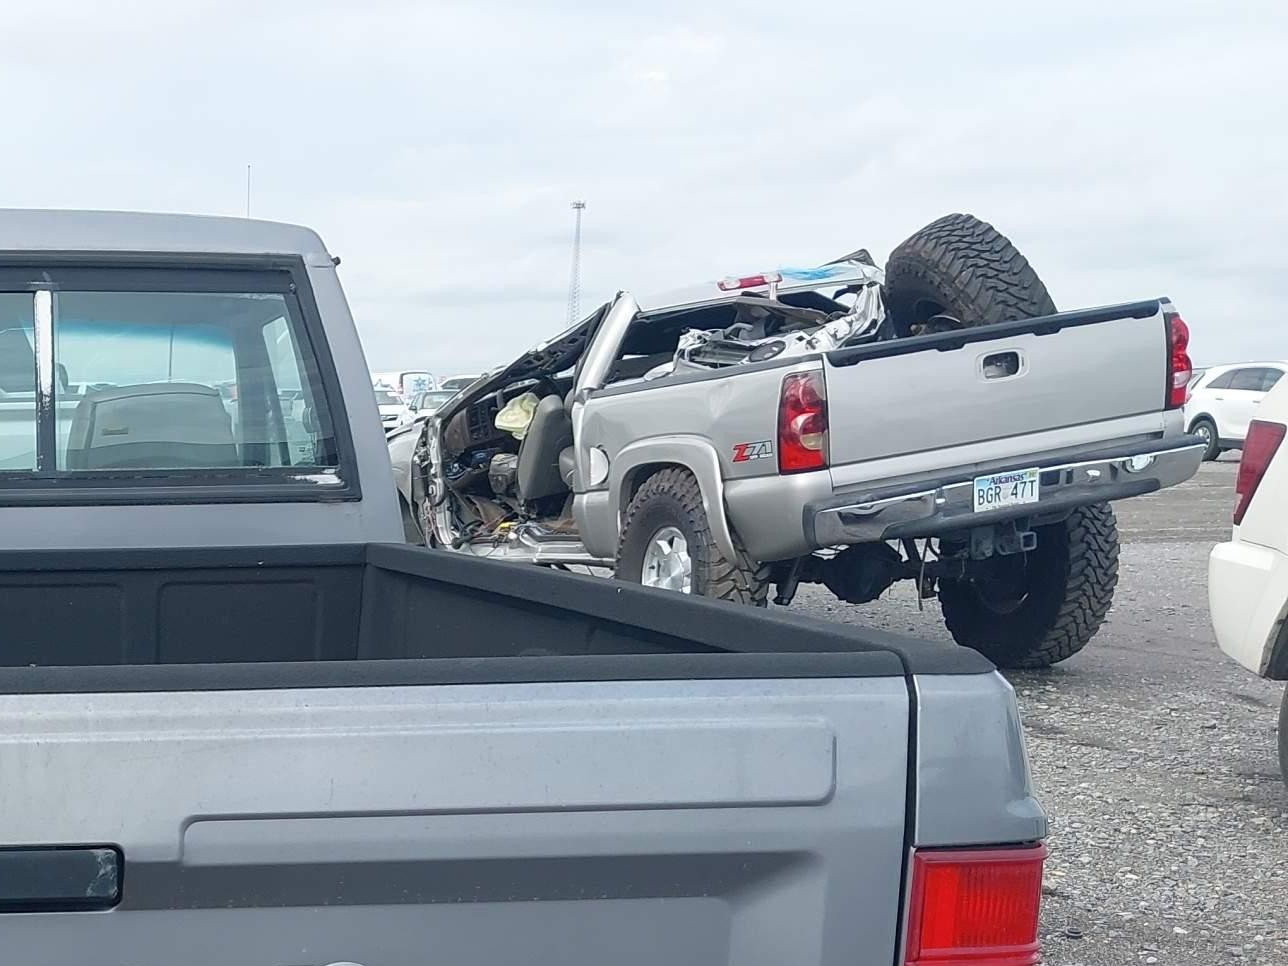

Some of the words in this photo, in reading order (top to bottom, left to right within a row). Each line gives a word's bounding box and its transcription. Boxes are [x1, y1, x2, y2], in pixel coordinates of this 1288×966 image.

[732, 440, 773, 462] Z71
[989, 474, 1025, 486] Arkansas
[977, 486, 1002, 506] BGR
[1010, 480, 1036, 499] 47T
